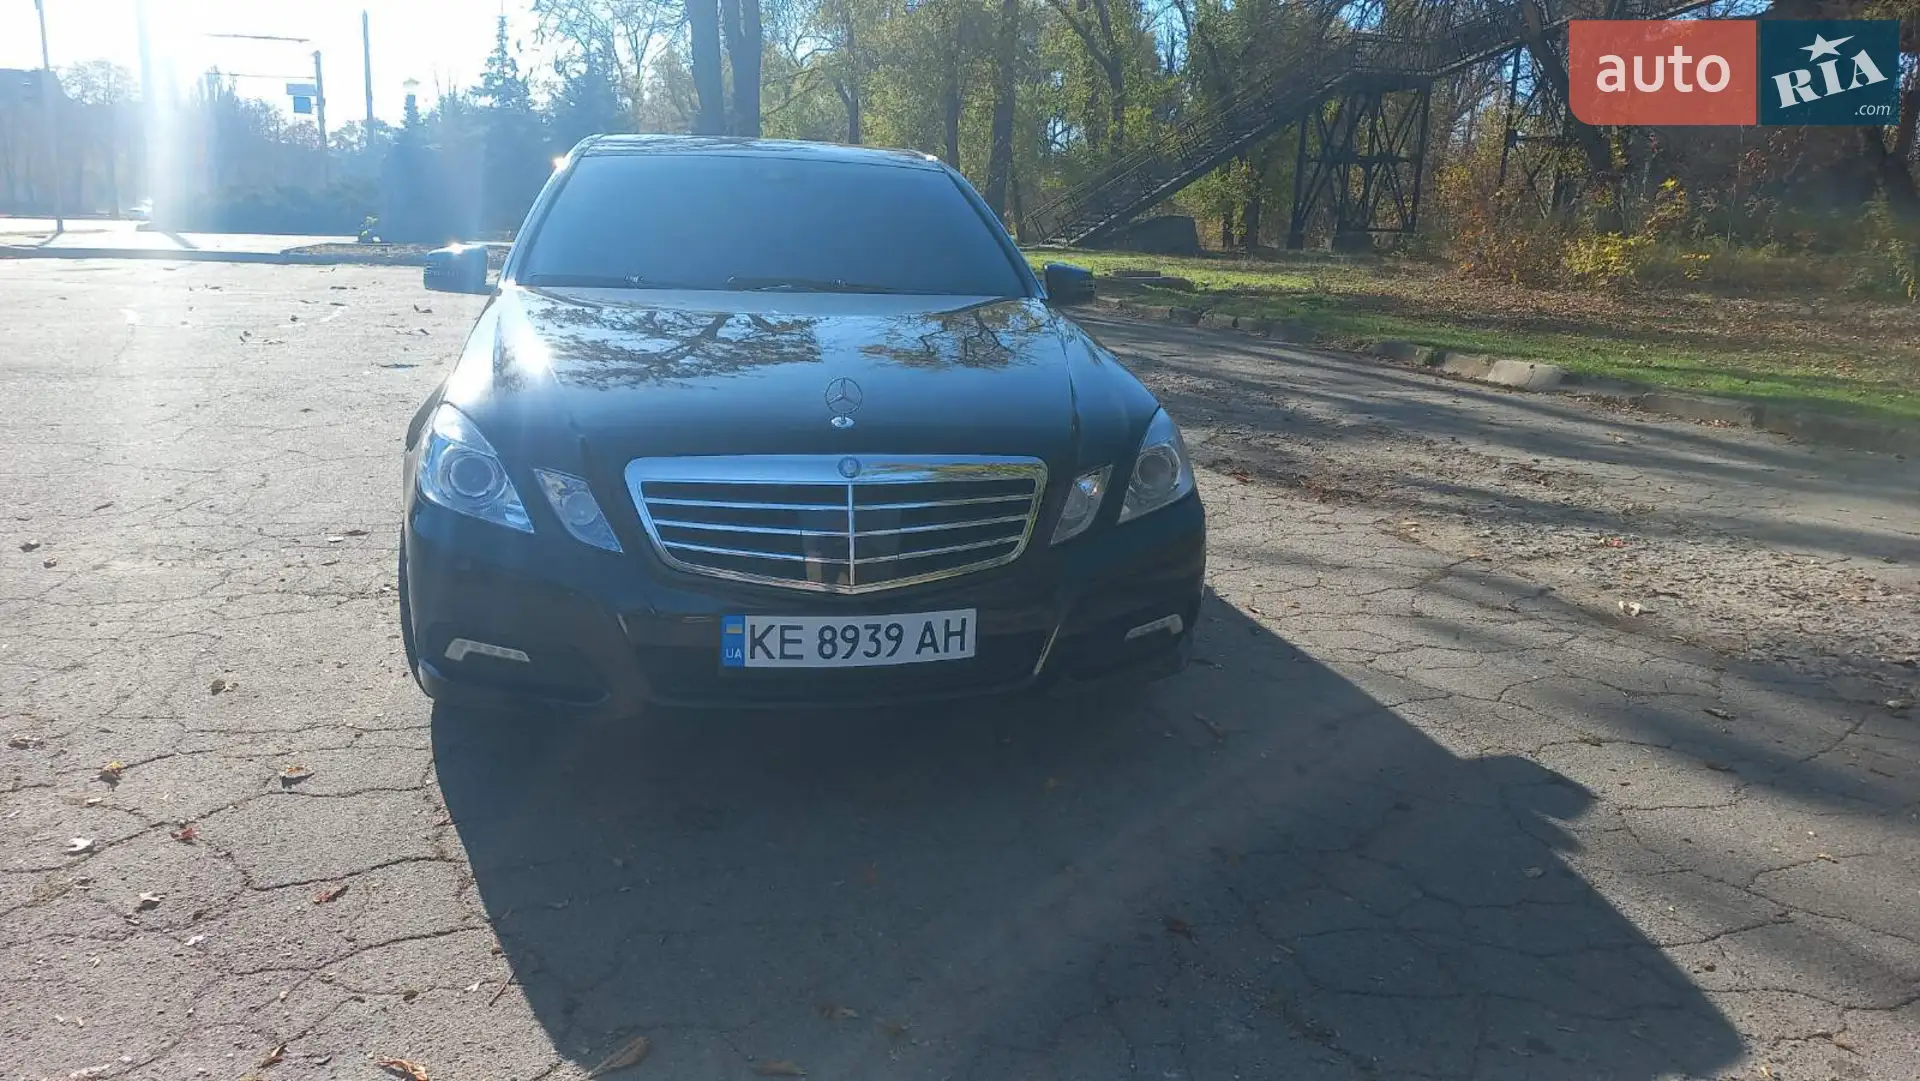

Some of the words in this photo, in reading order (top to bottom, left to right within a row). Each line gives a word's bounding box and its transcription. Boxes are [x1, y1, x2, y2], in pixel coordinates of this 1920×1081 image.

[749, 624, 804, 660] KE
[817, 622, 904, 660] 8939
[915, 617, 967, 655] AH
[725, 649, 743, 660] UA
